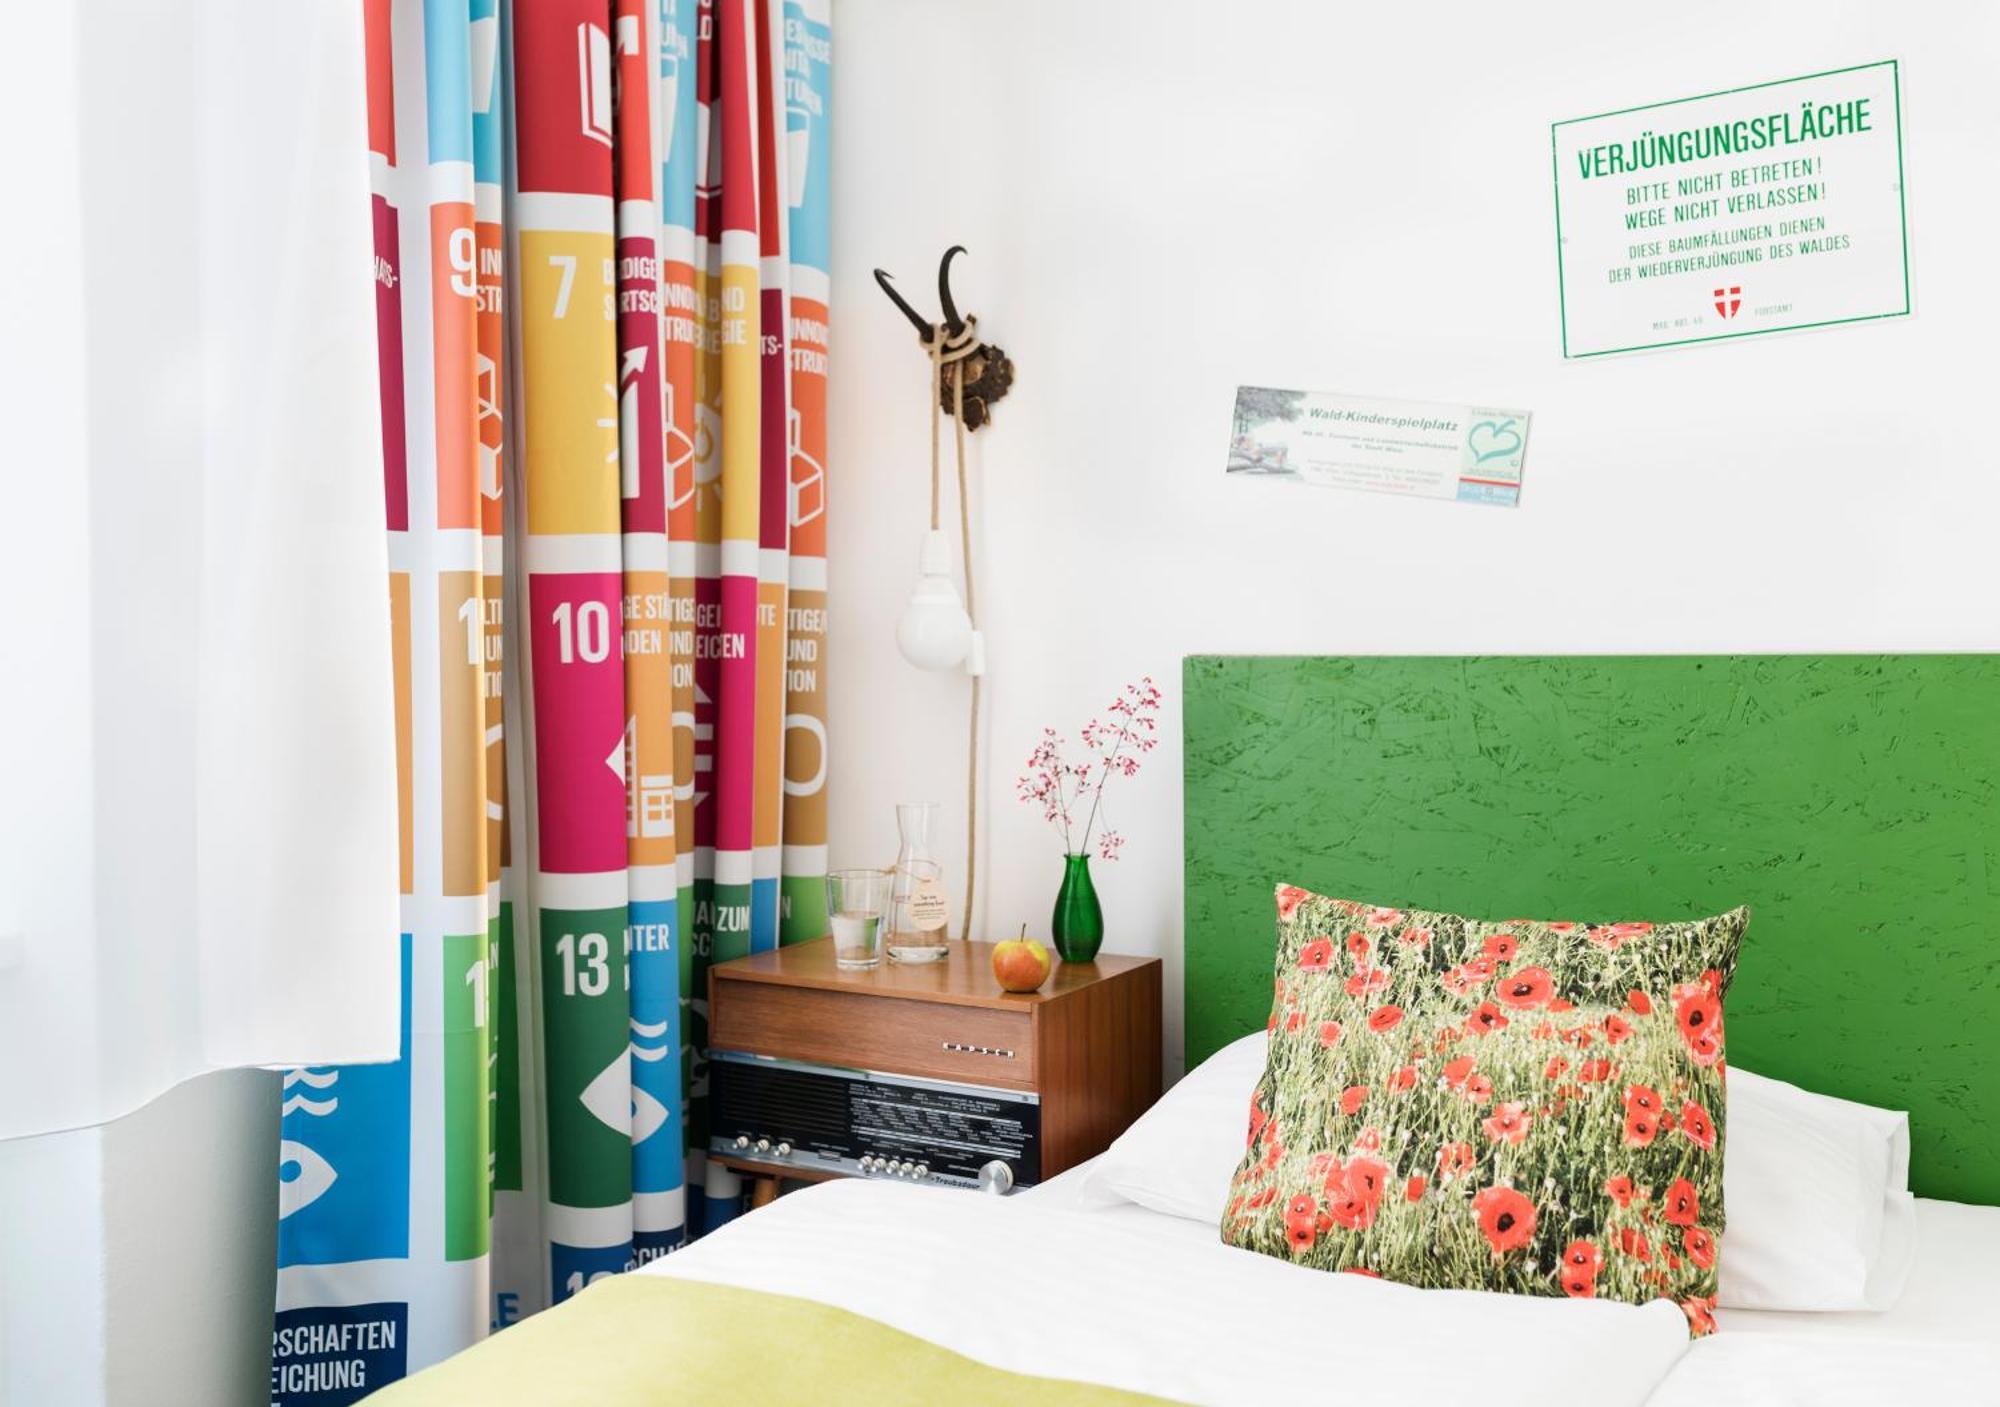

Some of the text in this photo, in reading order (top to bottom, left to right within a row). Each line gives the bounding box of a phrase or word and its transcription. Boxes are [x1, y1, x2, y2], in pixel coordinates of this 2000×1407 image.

[1578, 98, 1872, 179] VERJÜNGUNGSFLÄCHE
[1625, 208, 1667, 231] WEGE
[1674, 199, 1719, 224] NICHT
[1626, 182, 1670, 205] BITTE
[1678, 173, 1722, 199] NICHT
[449, 227, 477, 298] 9
[1608, 234, 1851, 284] DER WIEDERVERJÜNGUNG DES WALDES
[1629, 216, 1826, 260] DIESE BAUMFÄLLUNGEN DIENEN
[548, 255, 577, 319] 7
[1308, 406, 1459, 432] Wald-Kinderspielplatz
[552, 600, 611, 665] 10
[556, 932, 610, 996] 13
